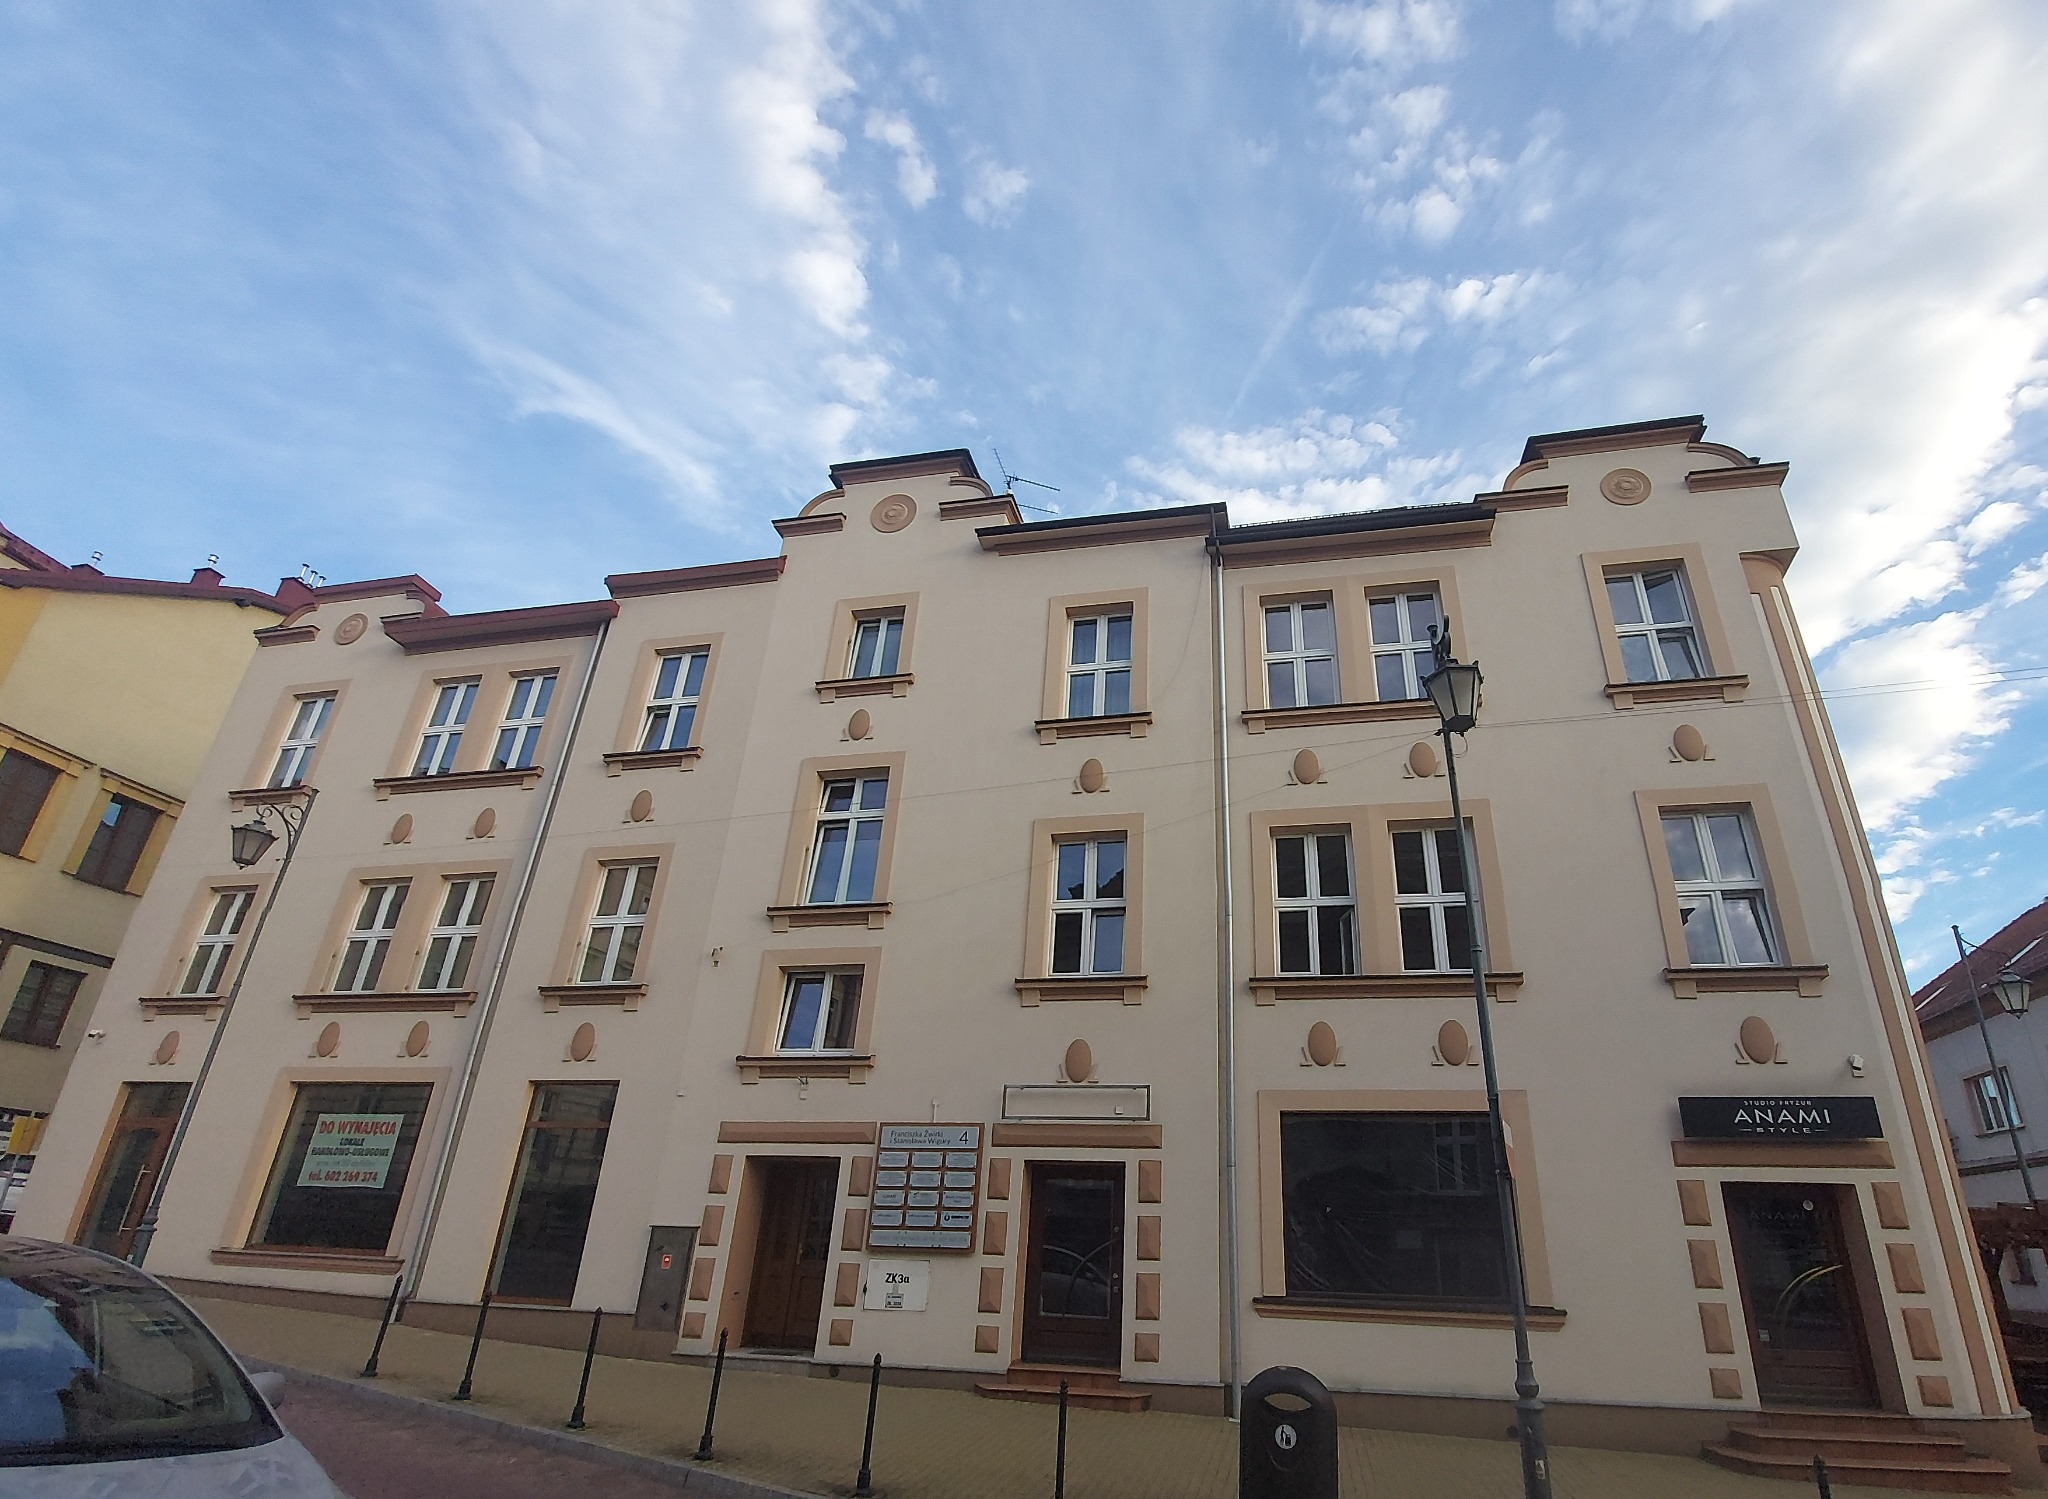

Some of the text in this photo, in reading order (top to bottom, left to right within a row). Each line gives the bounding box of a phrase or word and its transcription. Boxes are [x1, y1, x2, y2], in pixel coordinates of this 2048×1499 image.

[1734, 1108, 1831, 1124] ANAMI
[319, 1121, 397, 1136] DO WYNAJĘCIA
[890, 1129, 944, 1138] Franciszka Żwirki
[339, 1137, 365, 1146] LOKALE
[893, 1137, 928, 1145] Stanisława
[928, 1138, 951, 1146] Wigury
[959, 1130, 969, 1145] 4
[308, 1169, 378, 1182] tel. 602 269 374
[885, 1272, 910, 1284] ZK3a
